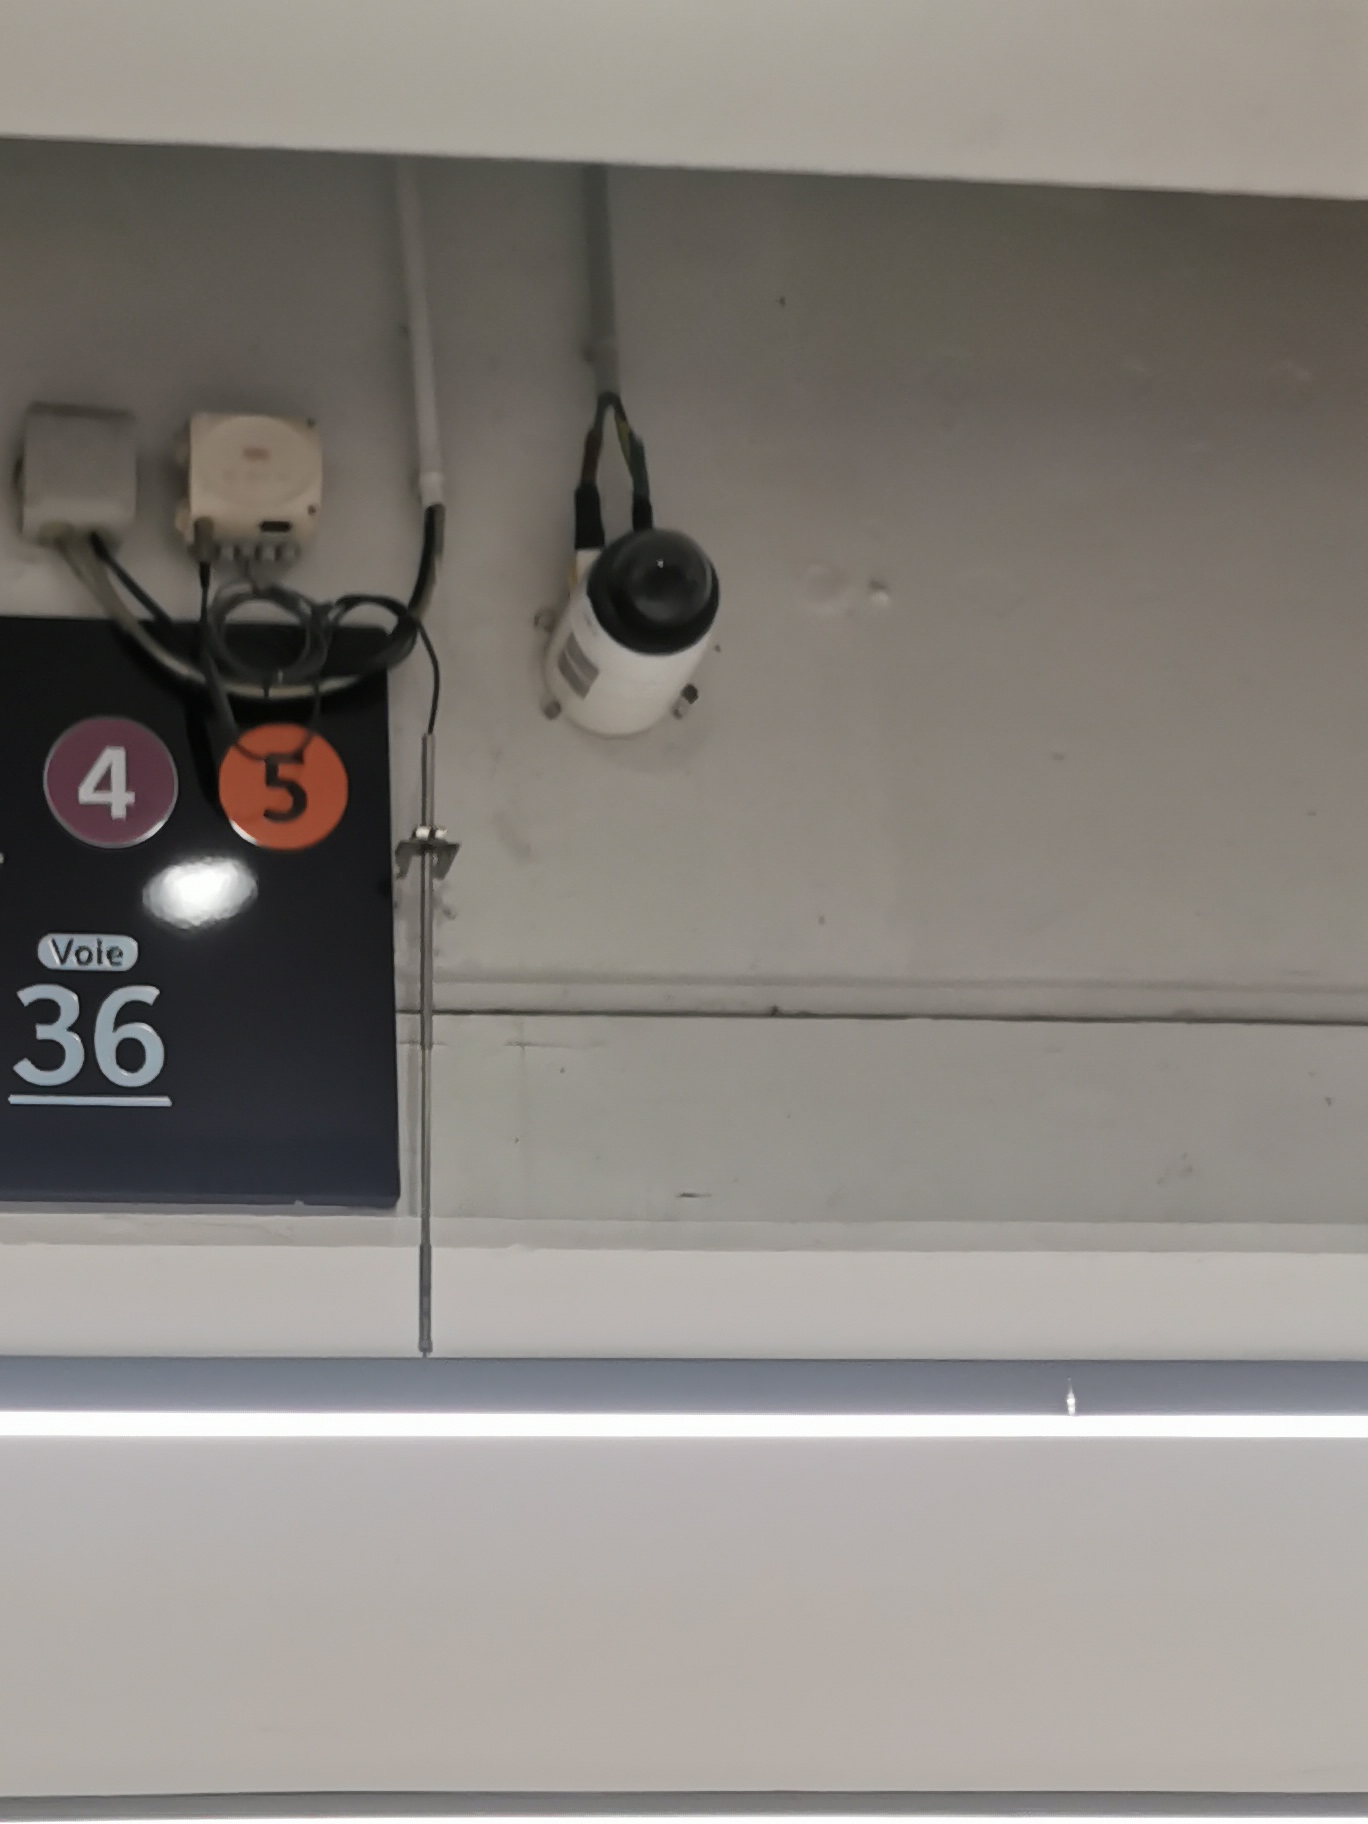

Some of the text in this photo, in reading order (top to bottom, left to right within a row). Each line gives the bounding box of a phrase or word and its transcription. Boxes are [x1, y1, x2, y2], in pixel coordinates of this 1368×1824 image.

[79, 747, 135, 820] 4
[263, 752, 308, 823] 5
[51, 940, 125, 969] Voie
[13, 984, 166, 1088] 36
